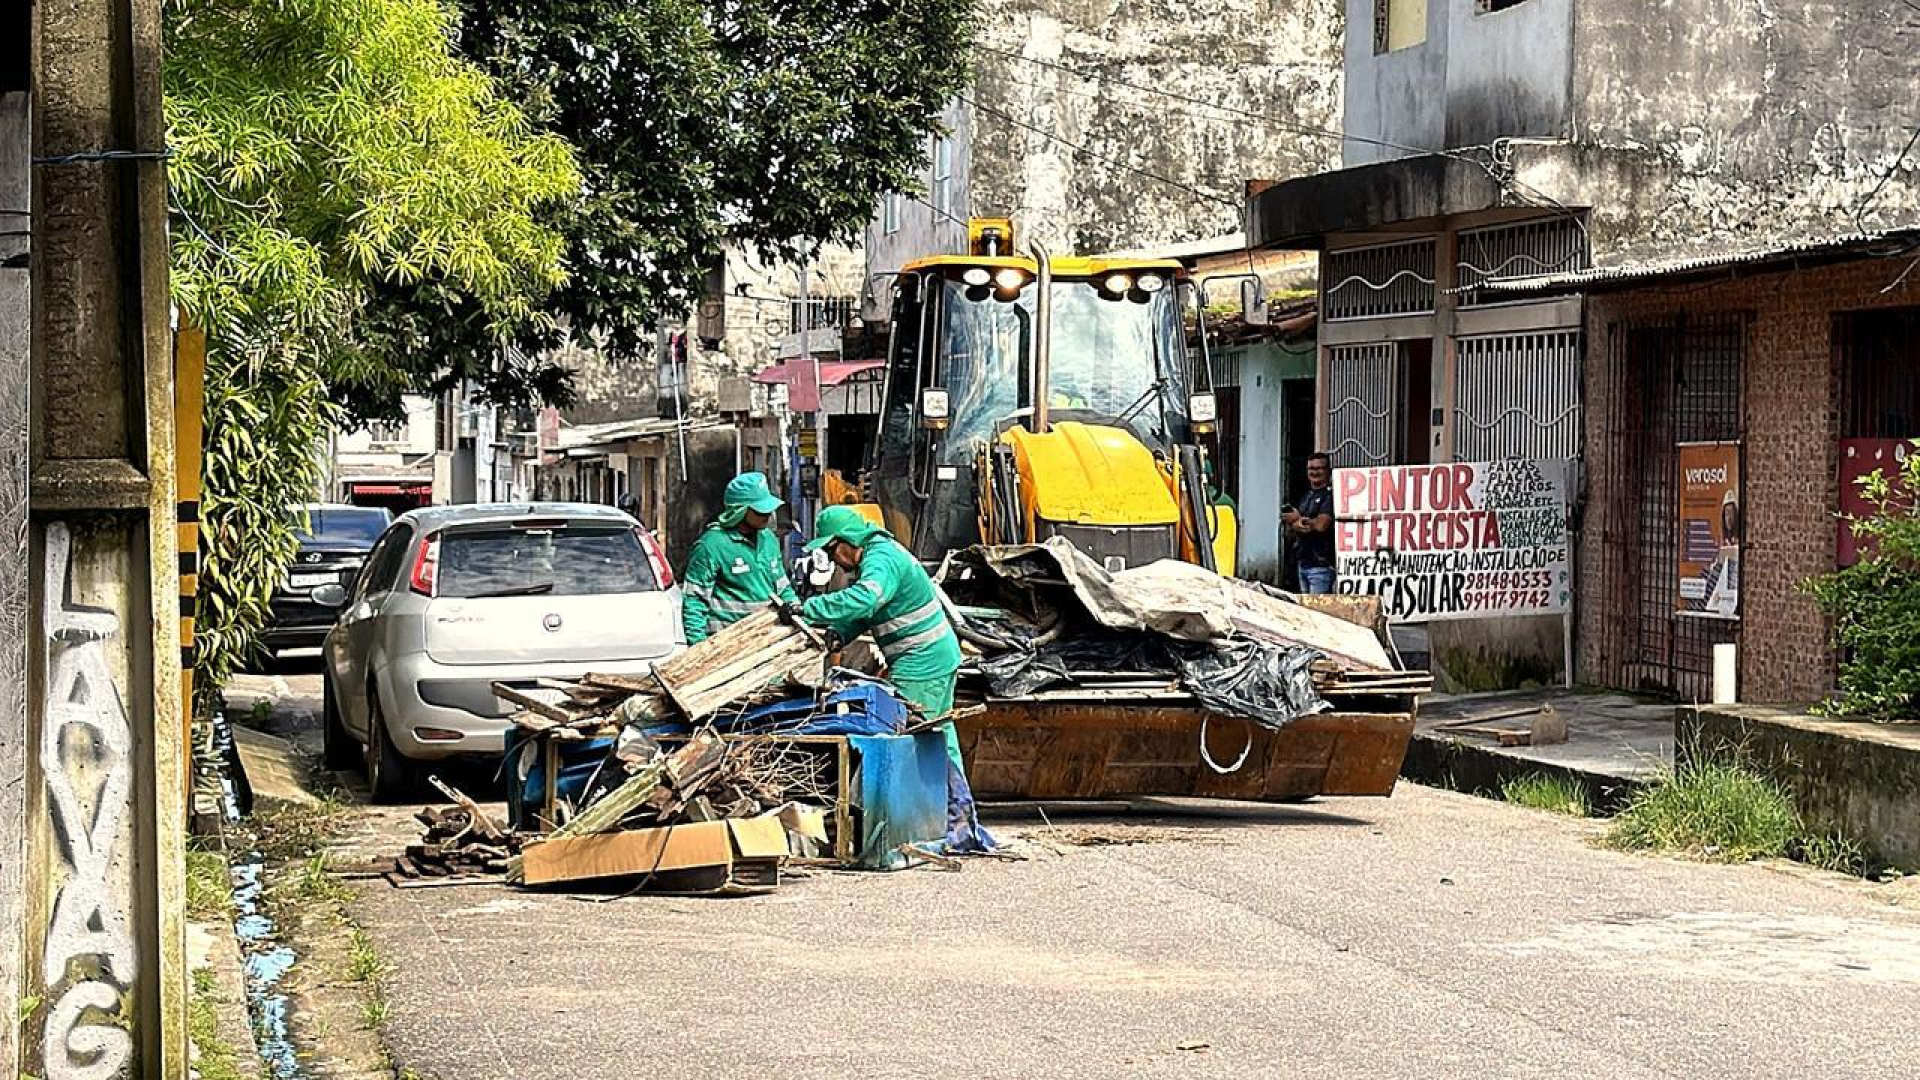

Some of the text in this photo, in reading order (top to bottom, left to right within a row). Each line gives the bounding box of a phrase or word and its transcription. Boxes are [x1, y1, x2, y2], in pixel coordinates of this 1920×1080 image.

[1685, 462, 1728, 484] verosol
[1337, 511, 1501, 552] ELETRECISTA
[1547, 549, 1567, 563] DE
